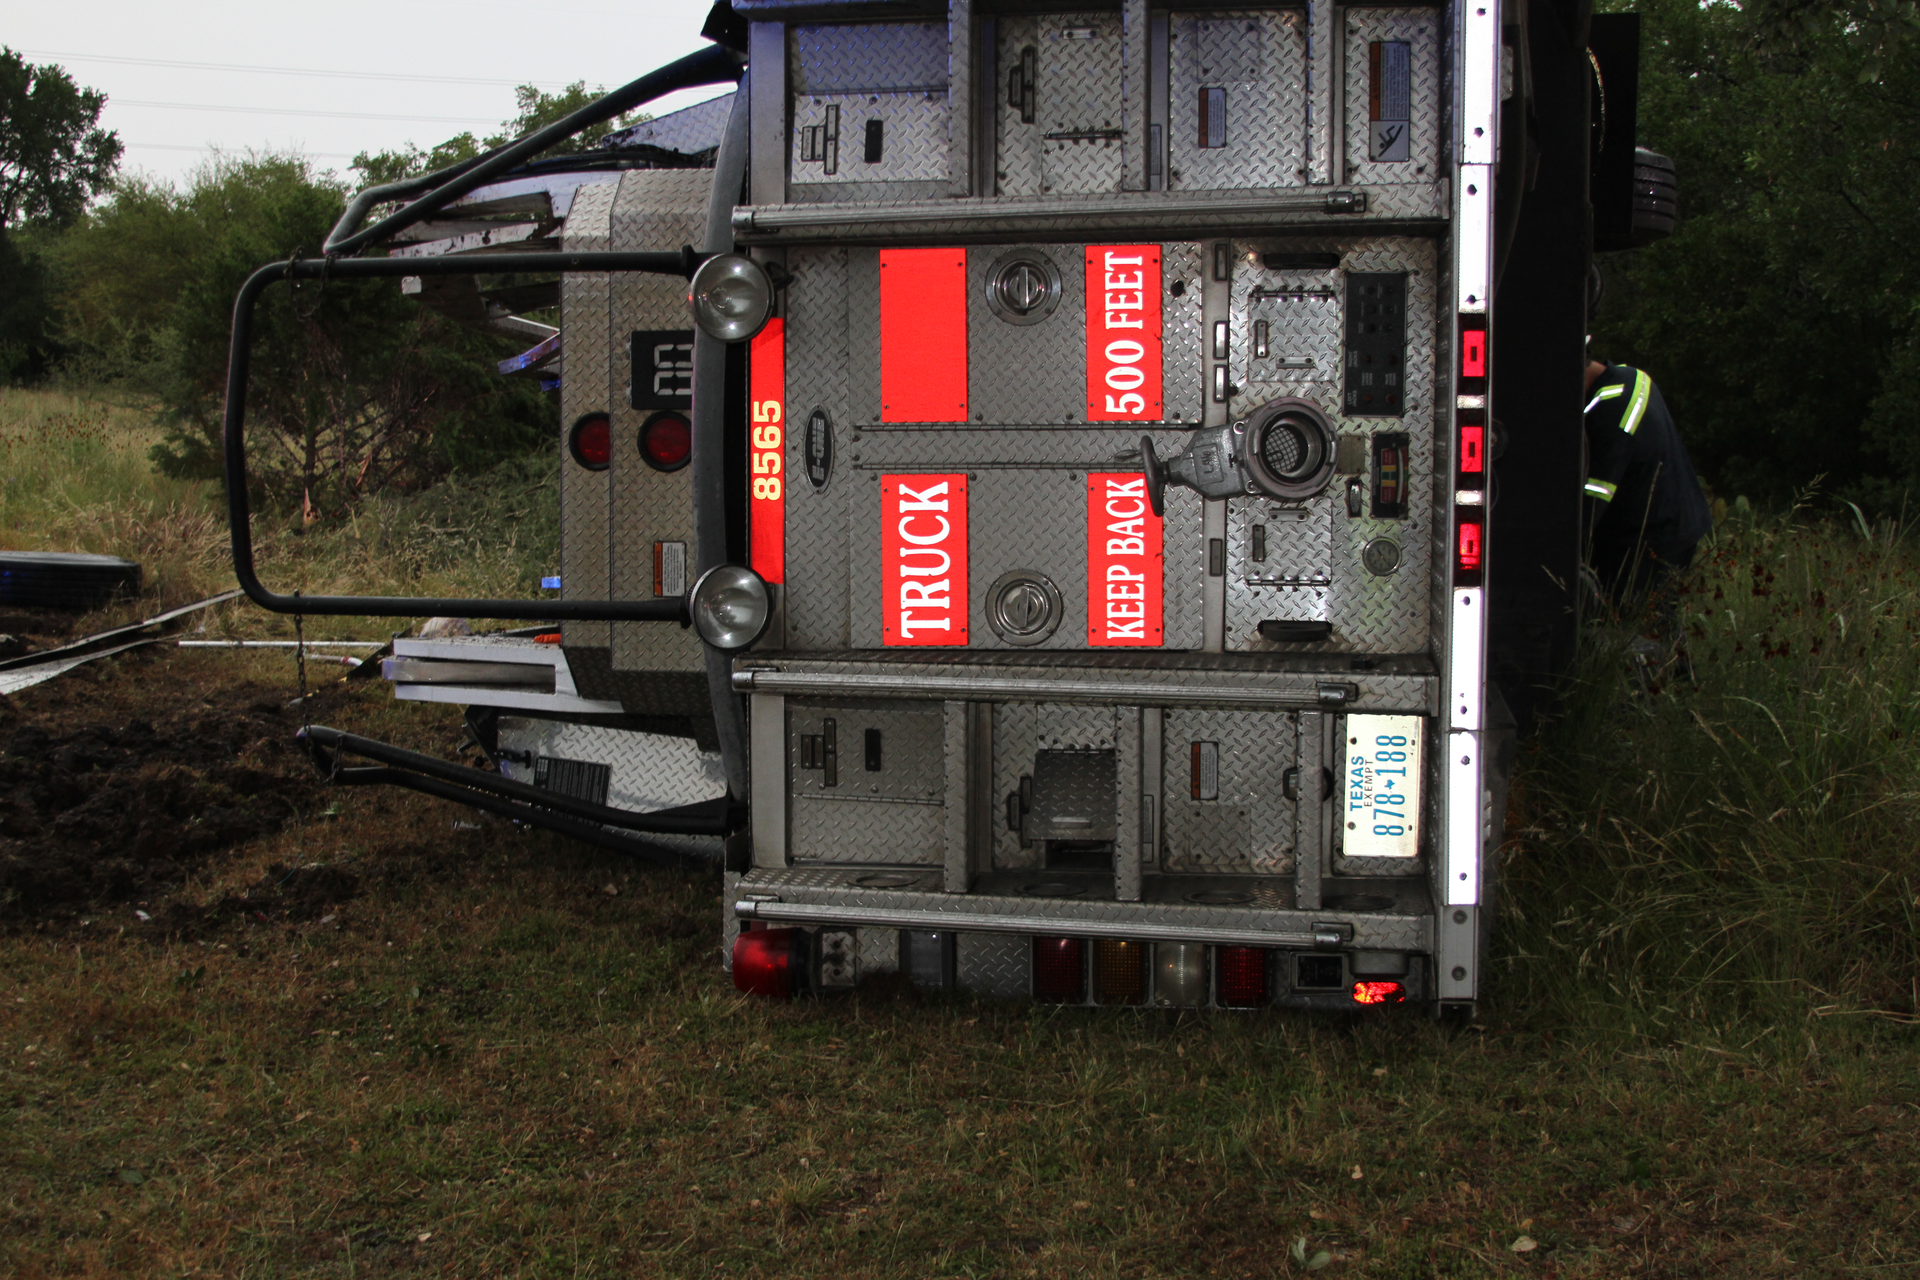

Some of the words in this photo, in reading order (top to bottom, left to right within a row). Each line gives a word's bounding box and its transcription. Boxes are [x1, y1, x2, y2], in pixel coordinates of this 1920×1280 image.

[1104, 251, 1144, 330] FEET
[1104, 340, 1145, 415] 500
[753, 400, 781, 501] 8565
[811, 416, 825, 482] E-ONE
[1105, 478, 1145, 556] BACK
[898, 481, 951, 639] TRUCK
[1105, 564, 1145, 640] KEEP
[1350, 755, 1365, 812] TEXAS
[1364, 759, 1373, 807] EXEMPT
[1374, 735, 1407, 777] 188
[1373, 793, 1406, 837] 878
